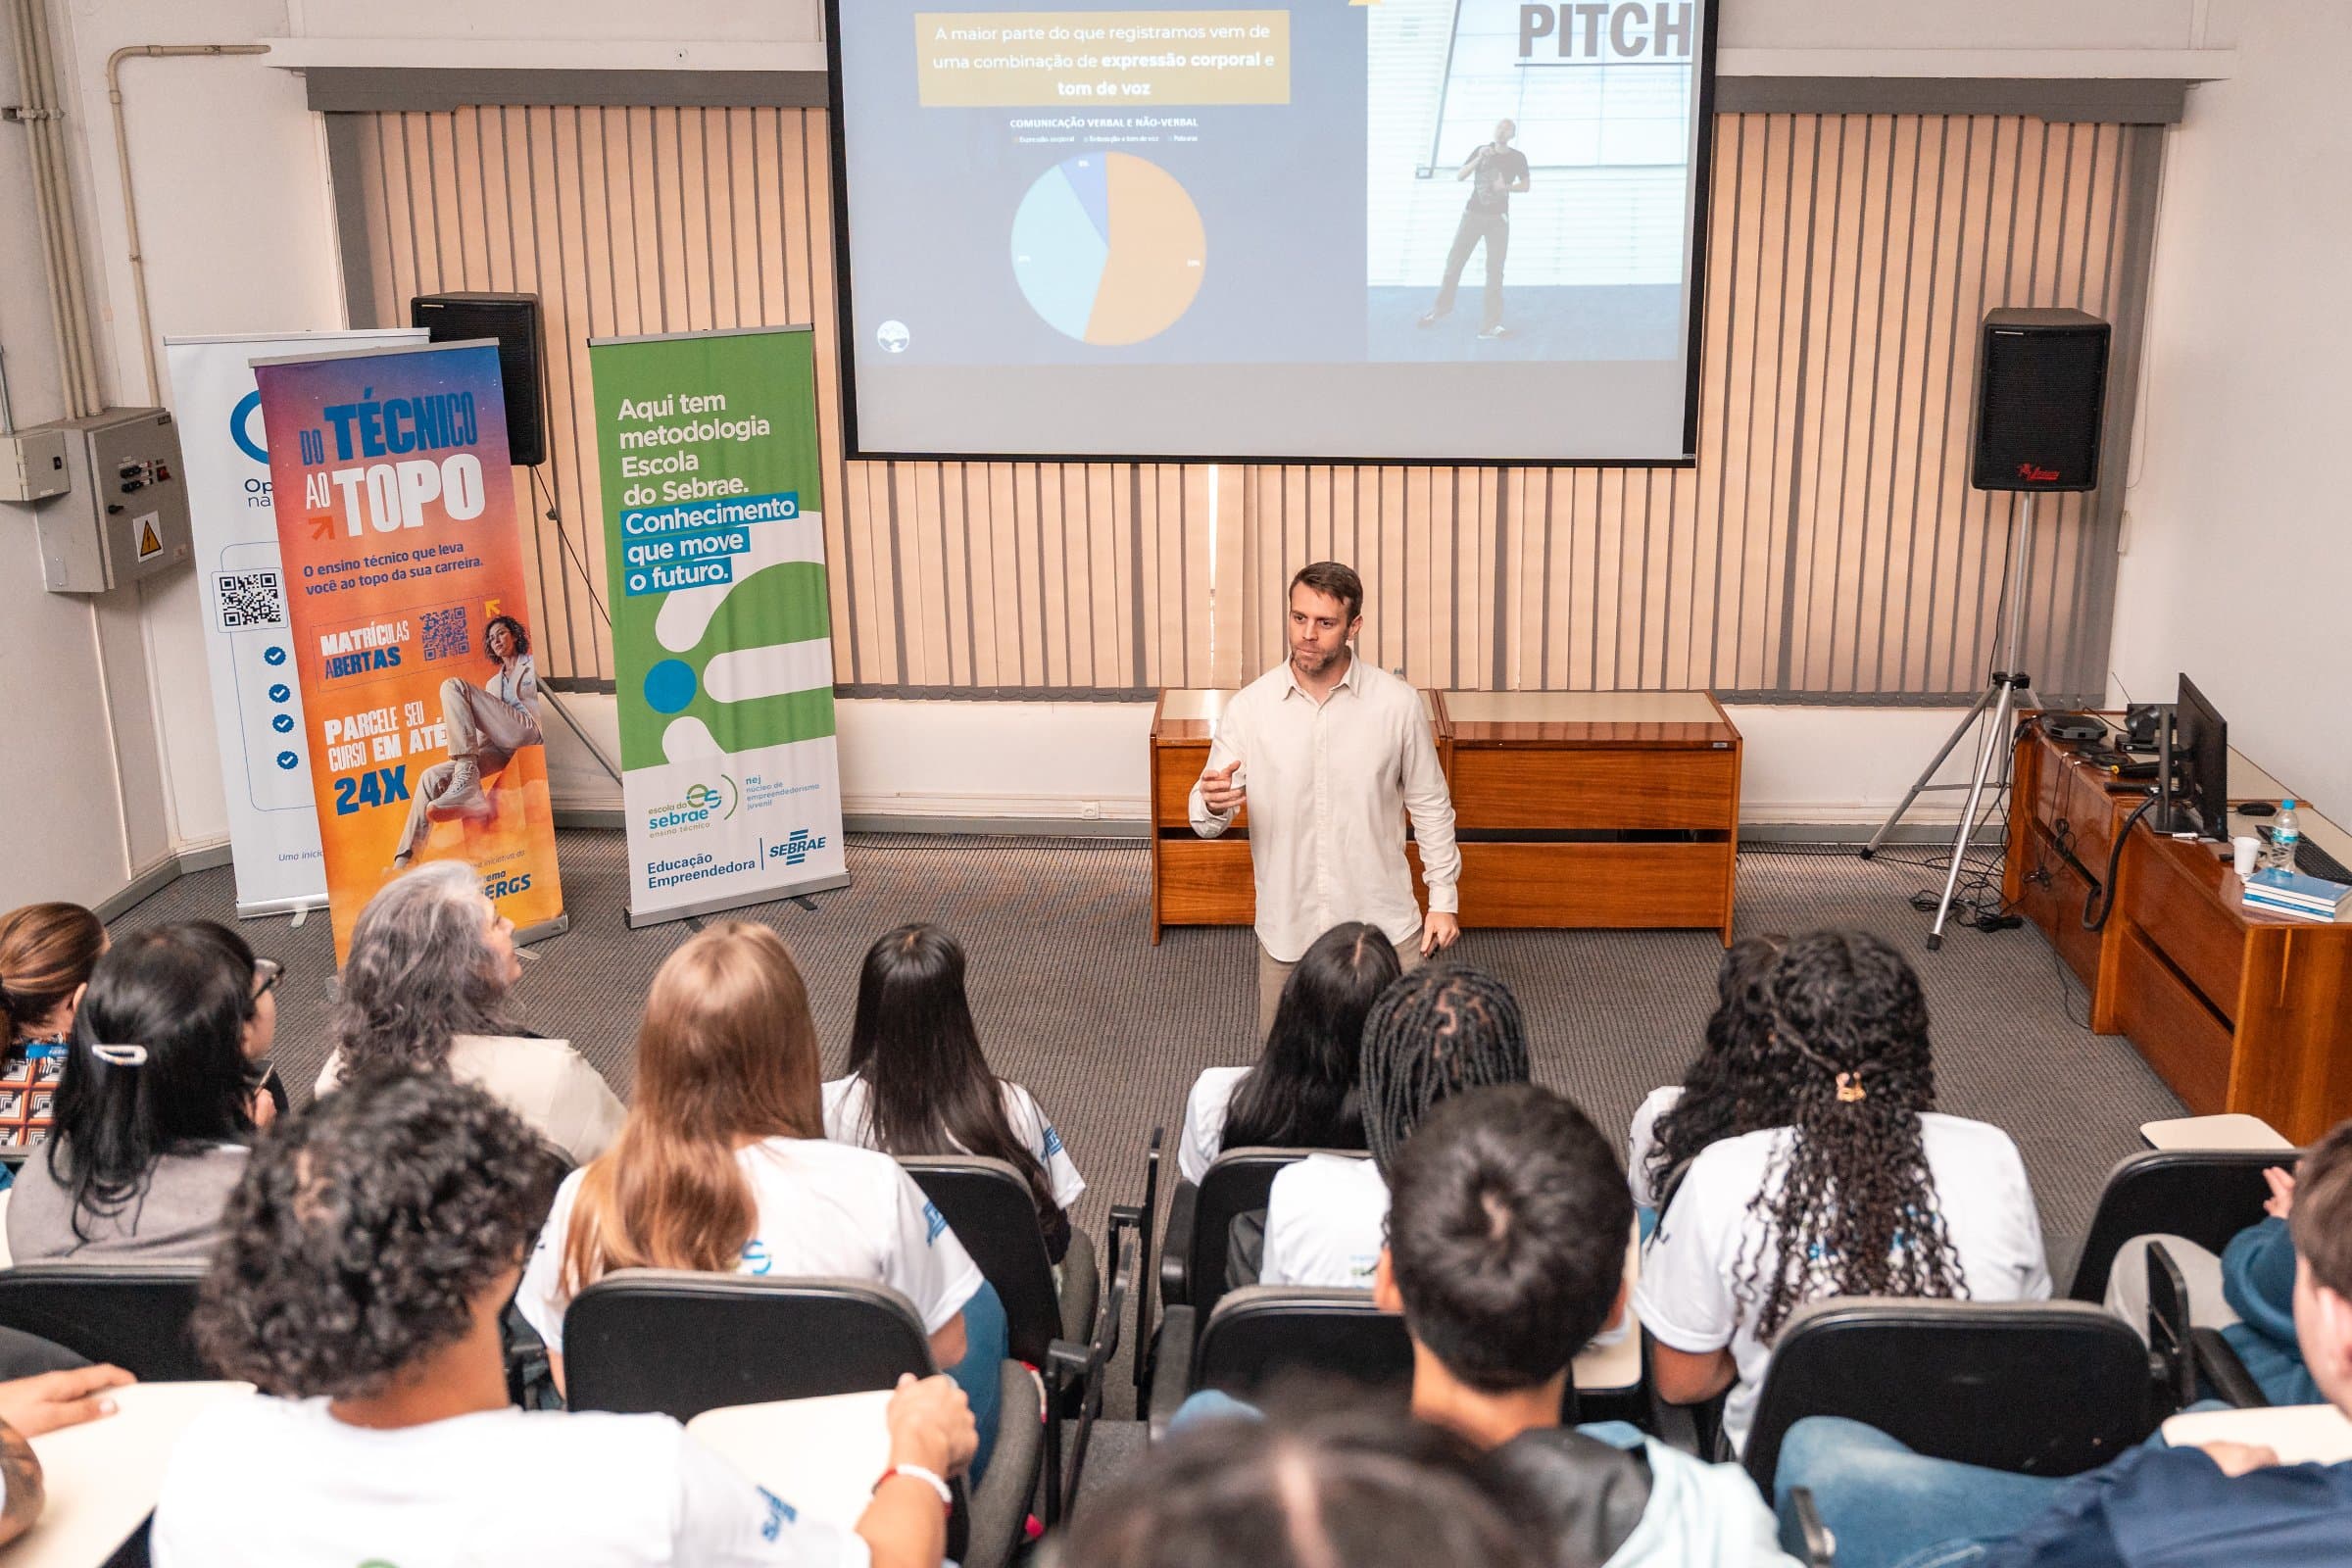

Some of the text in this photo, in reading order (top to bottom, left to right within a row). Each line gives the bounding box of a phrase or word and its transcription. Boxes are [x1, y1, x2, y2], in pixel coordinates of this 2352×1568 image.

[935, 24, 1271, 43] A maior parte do que registramos vem de
[1519, 3, 1692, 57] PITCH
[933, 52, 1275, 71] uma combinação de expressão corporal e
[1057, 80, 1152, 95] tom de voz
[1009, 116, 1200, 128] COMUNICAÇÃO VERBAL E NÃO-VERBAL
[617, 393, 726, 422] Aqui tem
[299, 386, 477, 466] DO TÉCNICO
[619, 415, 770, 450] metodologia
[621, 450, 699, 478] Escola
[306, 453, 485, 537] AO TOPO
[623, 477, 750, 507] do Sebrae.
[625, 497, 796, 534] Conhecimento
[303, 543, 465, 577] O ensino técnico que leva
[627, 532, 744, 566] que move
[306, 557, 483, 596] você ao topo da sua carreira.
[629, 563, 729, 591] o futuro.
[320, 620, 410, 657] MATRÍCULAS
[325, 646, 402, 679] ABERTAS
[323, 700, 425, 746] PARCELE SEU
[328, 716, 449, 772] CURSO EM ATÉ
[334, 764, 411, 816] 24X
[746, 776, 761, 786] nej
[648, 804, 675, 814] escola
[649, 808, 710, 830] sebrae
[769, 836, 827, 858] SEBRAE
[648, 853, 713, 875] Educação
[648, 859, 756, 890] Empreendedora
